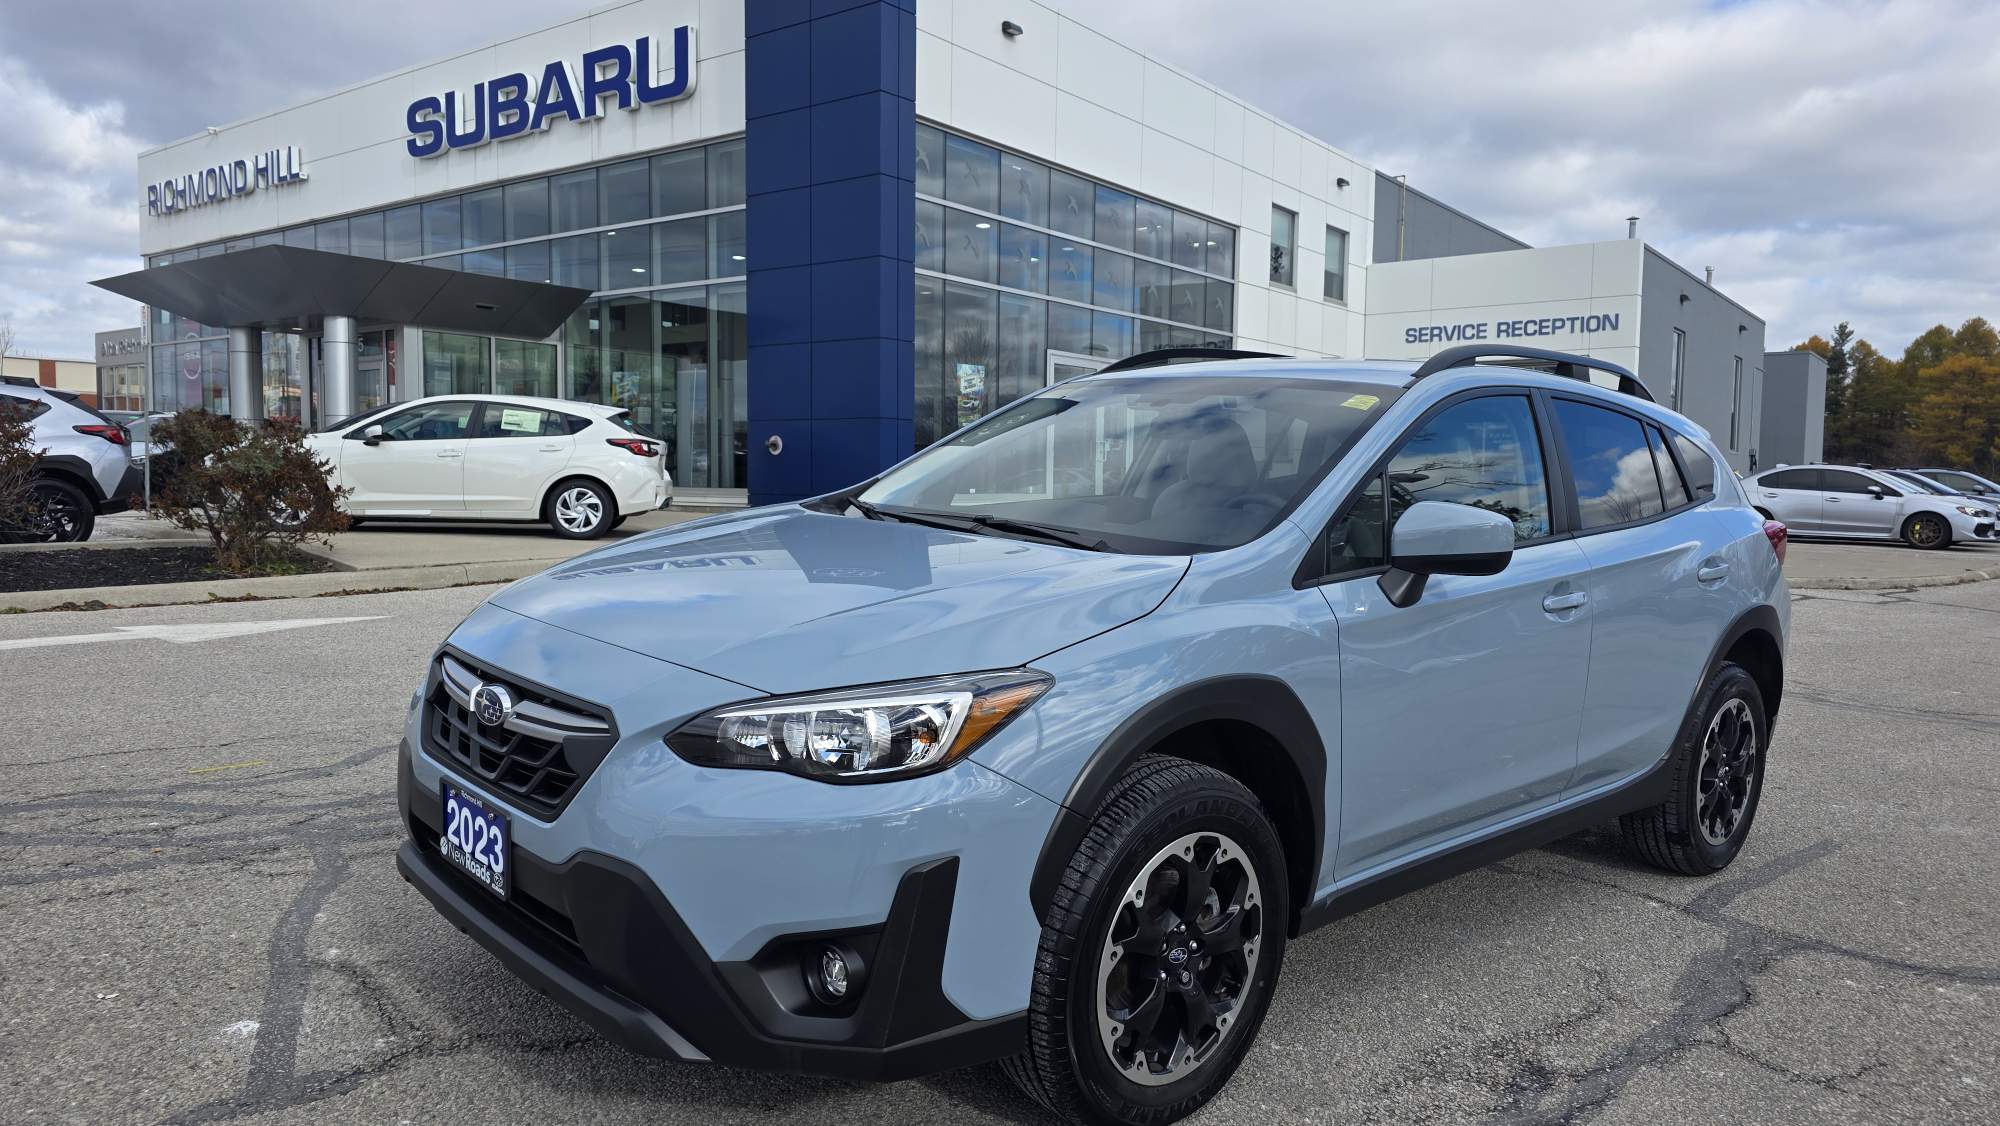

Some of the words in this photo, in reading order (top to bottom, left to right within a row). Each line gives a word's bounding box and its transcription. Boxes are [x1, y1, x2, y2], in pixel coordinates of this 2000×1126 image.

[406, 25, 692, 158] SUBARU
[147, 159, 250, 217] RICHMOND
[255, 146, 303, 191] HILL
[1404, 322, 1488, 344] SERVICE
[1496, 313, 1620, 339] RECEPTION
[447, 799, 503, 873] 2023
